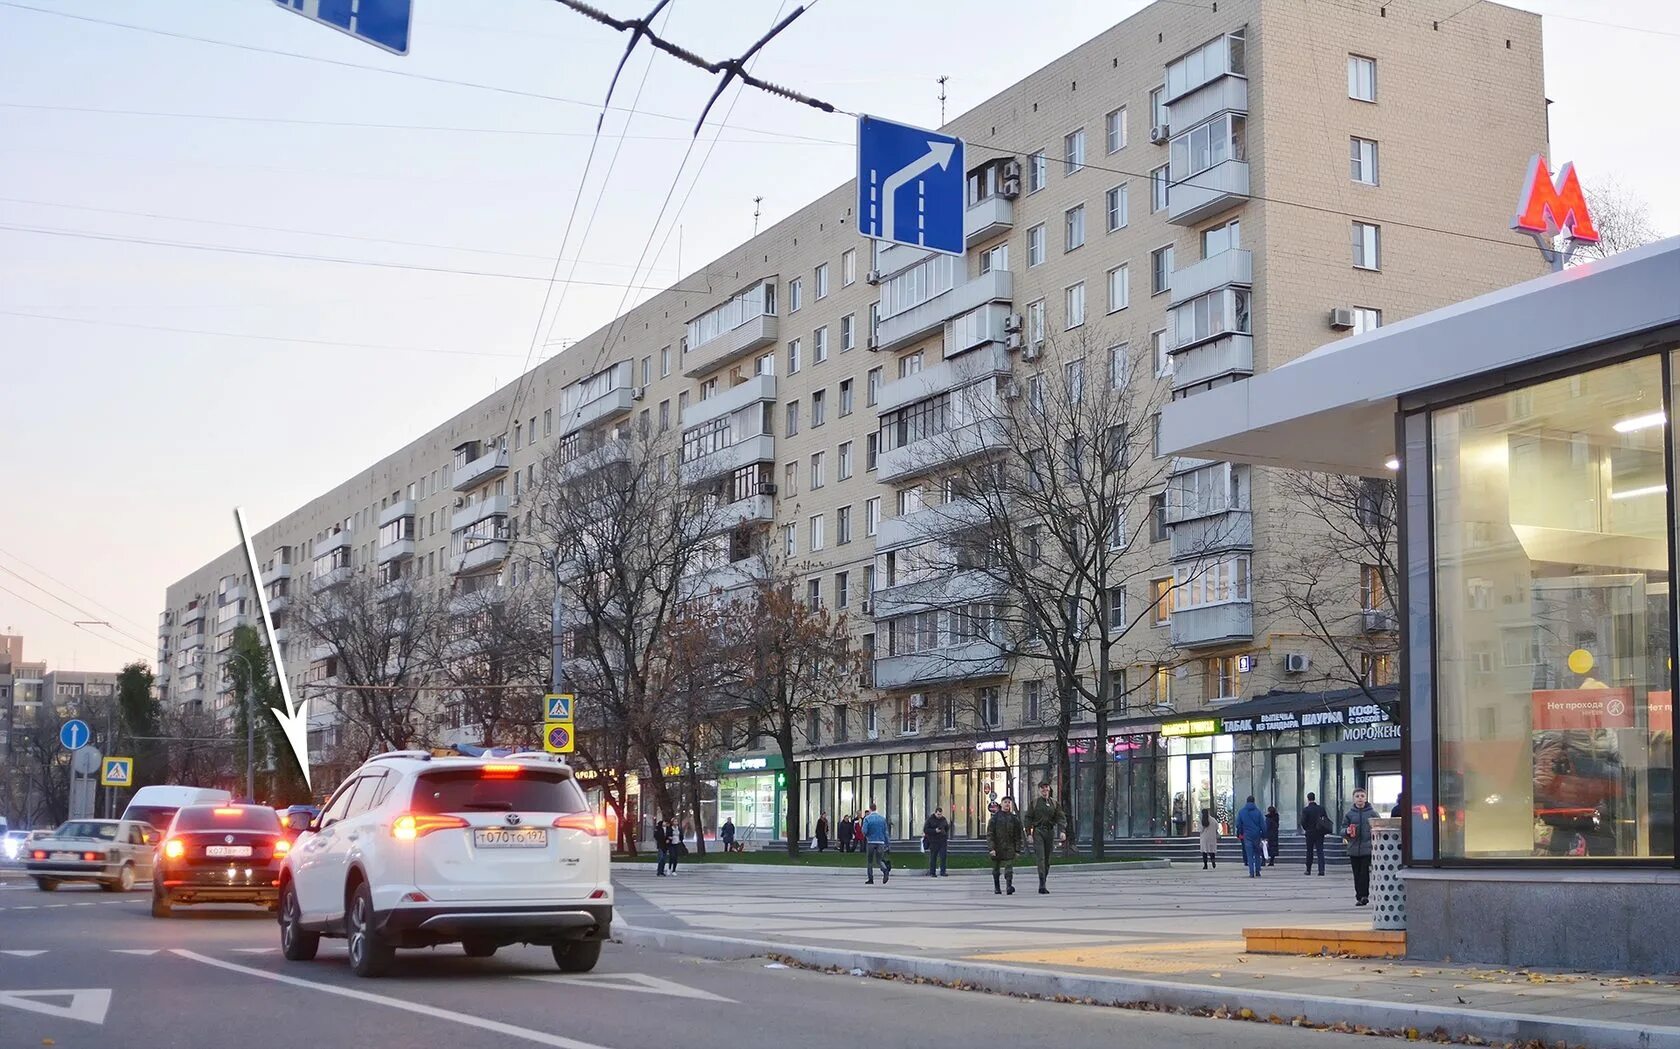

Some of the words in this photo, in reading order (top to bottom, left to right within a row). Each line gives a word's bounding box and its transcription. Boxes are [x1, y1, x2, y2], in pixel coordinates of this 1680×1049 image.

[1512, 152, 1600, 243] М
[1348, 704, 1380, 716] КОФЕ
[1547, 702, 1564, 710] Нет
[1566, 701, 1604, 711] прохода
[1261, 712, 1295, 722] ВЫПЕЧКА
[1301, 711, 1344, 726] ШАУРМА
[1355, 714, 1380, 724] СОБОЙ
[1223, 719, 1253, 733] ТАБАК
[1256, 723, 1265, 731] ИЗ
[1266, 720, 1299, 730] ТАНДЫРА
[527, 830, 543, 839] 197
